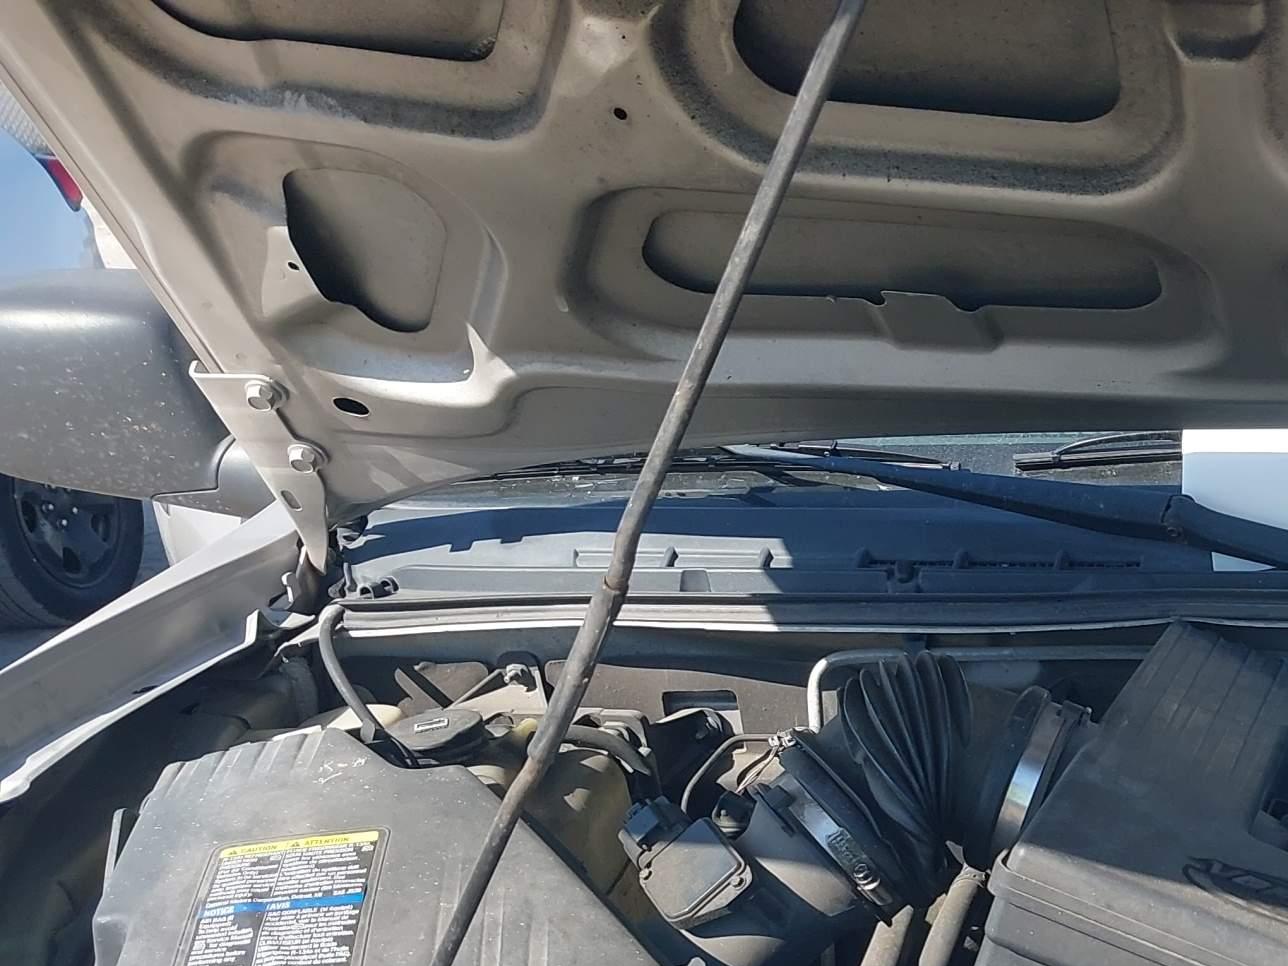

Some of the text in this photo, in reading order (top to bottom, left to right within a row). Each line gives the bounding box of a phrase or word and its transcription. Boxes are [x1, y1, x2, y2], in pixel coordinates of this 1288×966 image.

[304, 836, 350, 847] ATTENTION
[241, 844, 278, 854] CAUTION
[270, 901, 291, 910] AVIS
[203, 906, 236, 917] NOTICE
